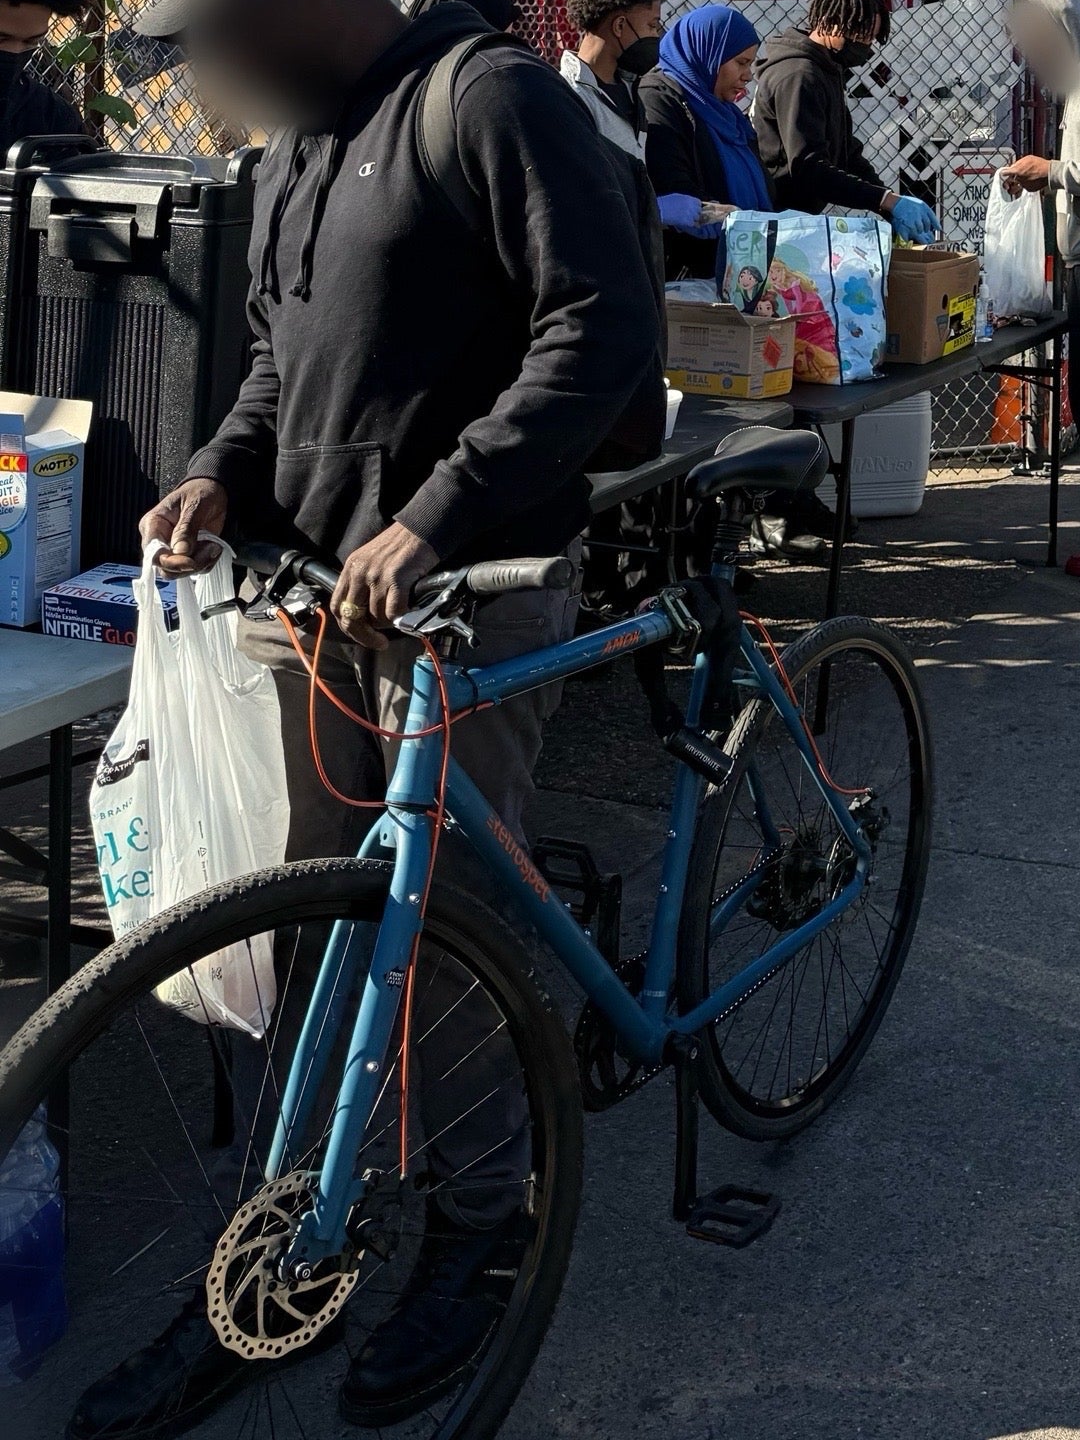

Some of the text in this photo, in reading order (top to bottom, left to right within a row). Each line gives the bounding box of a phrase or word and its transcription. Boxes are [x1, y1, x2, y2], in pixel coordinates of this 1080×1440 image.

[963, 185, 991, 201] ONLY
[953, 206, 986, 222] RKING
[0, 456, 21, 471] CK
[48, 585, 112, 601] NITRILE
[45, 604, 78, 615] Powder Free
[45, 611, 111, 627] Nitrile Examination Gloves
[45, 618, 137, 647] NITRILE GLO
[684, 742, 721, 771] KRYPTONITE
